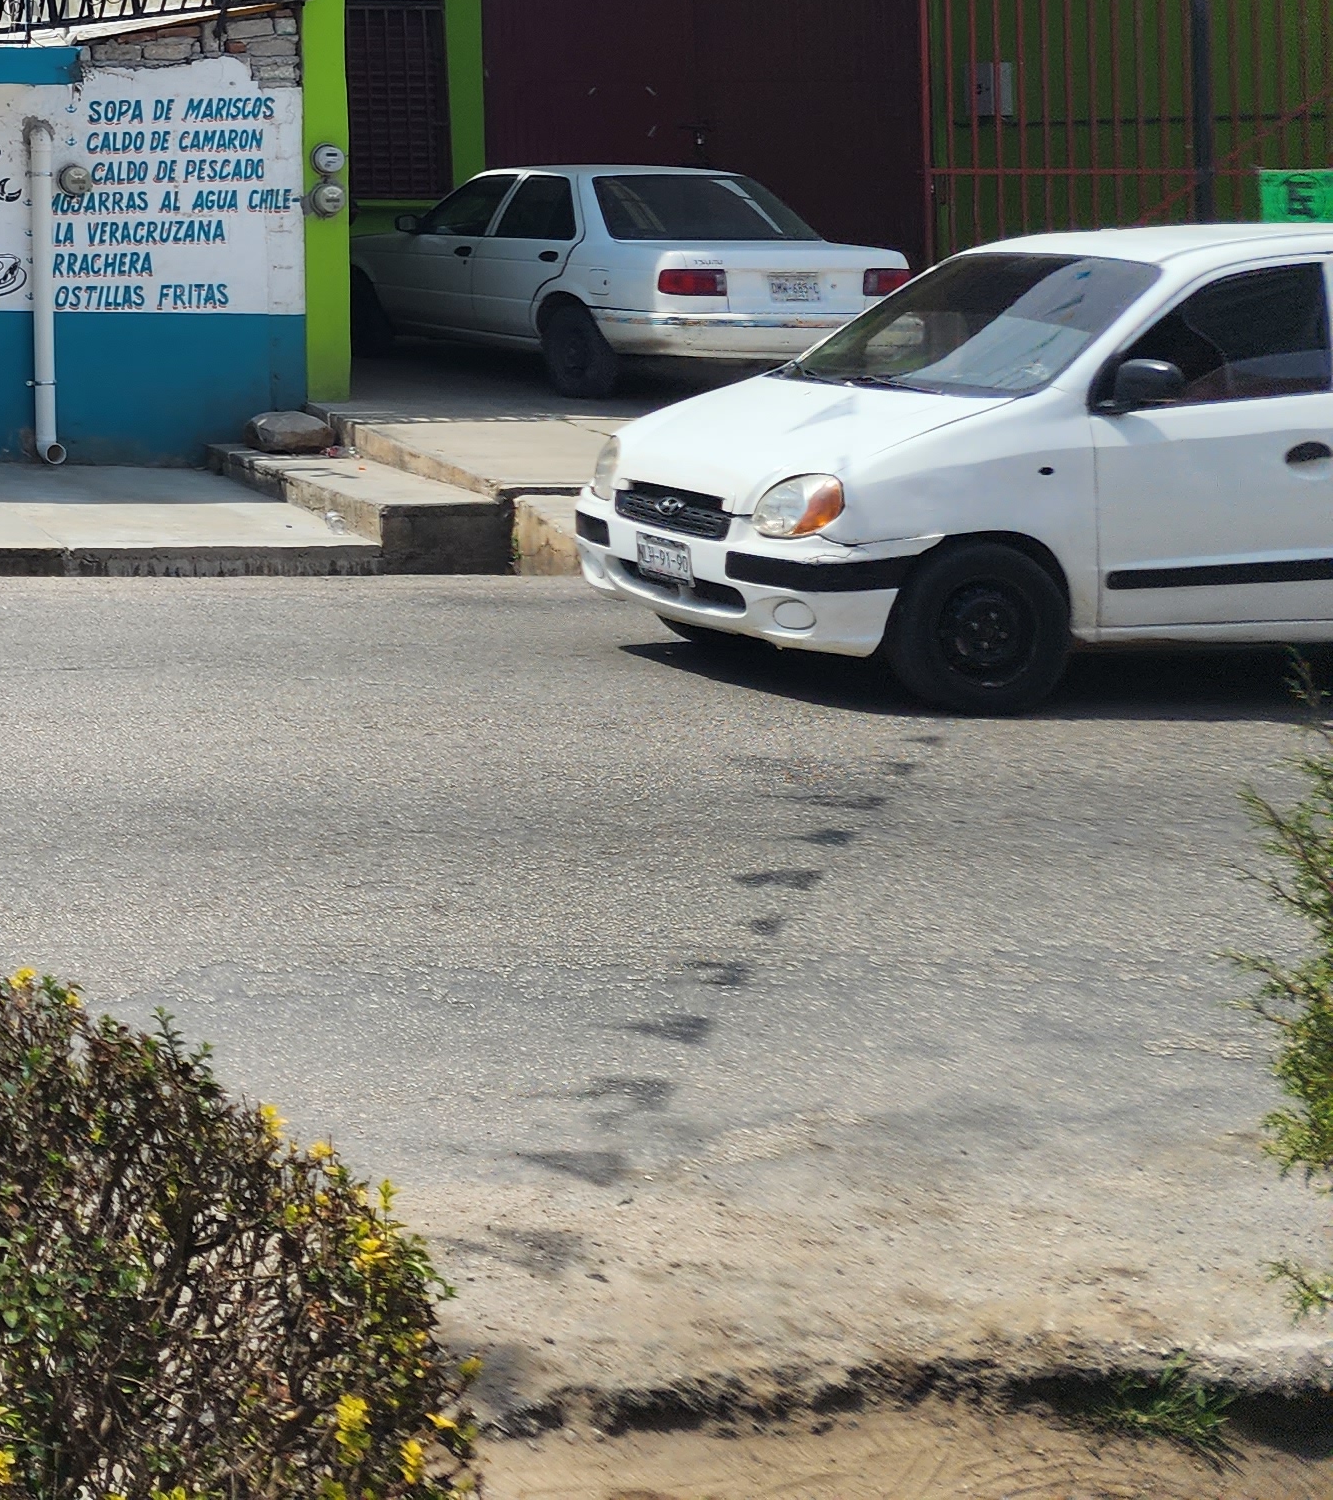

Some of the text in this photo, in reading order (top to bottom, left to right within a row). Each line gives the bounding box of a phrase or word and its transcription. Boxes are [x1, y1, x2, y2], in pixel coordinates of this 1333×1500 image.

[88, 97, 275, 124] SOPA DE MARISCOS
[86, 128, 264, 154] CALDO DE CAMARON
[92, 159, 264, 184] CALDO DE PESCADO
[158, 190, 181, 213] AL
[191, 190, 238, 213] AGUA
[53, 219, 226, 247] LA VERACRUZANA
[52, 252, 153, 276] RRACHERA
[54, 283, 229, 310] OSTILLAS FRITAS
